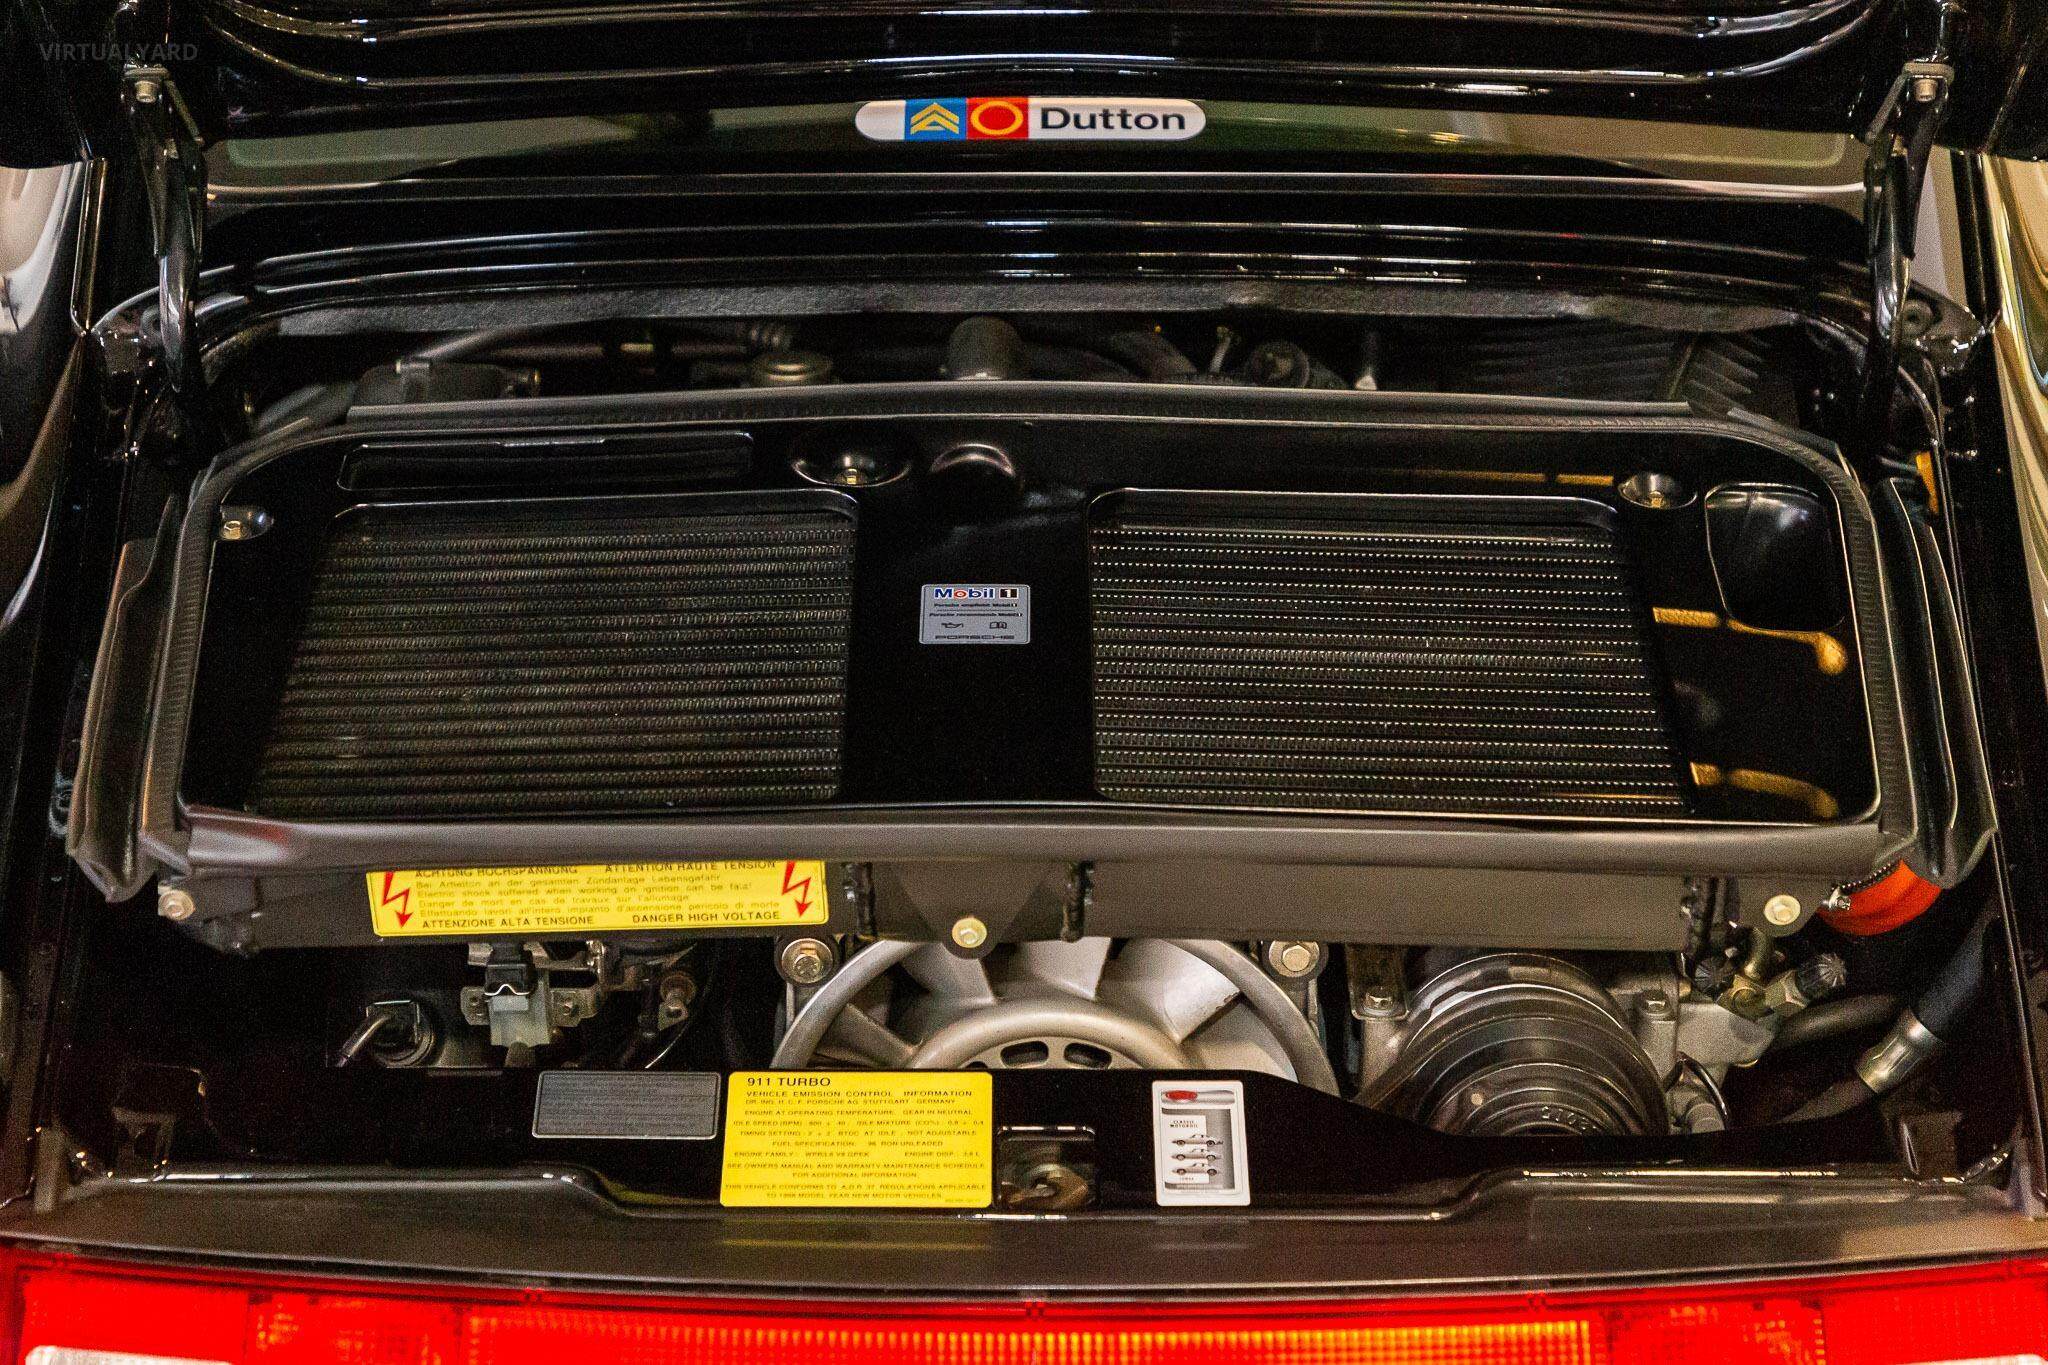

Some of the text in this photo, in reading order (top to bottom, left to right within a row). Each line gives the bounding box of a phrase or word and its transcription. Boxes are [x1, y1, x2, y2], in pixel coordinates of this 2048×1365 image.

[1040, 106, 1186, 129] Dutton
[934, 588, 994, 598] Mobil
[415, 866, 578, 878] ACHTUNG HOCHSPANNUNG
[605, 861, 775, 873] ATTENTION HAUTE TENSION
[422, 915, 593, 928] ATTENZIONE ALTA TENSIONE
[631, 911, 780, 923] DANGER HIGH VOLTAGE
[747, 1077, 831, 1087] 911 TURBO
